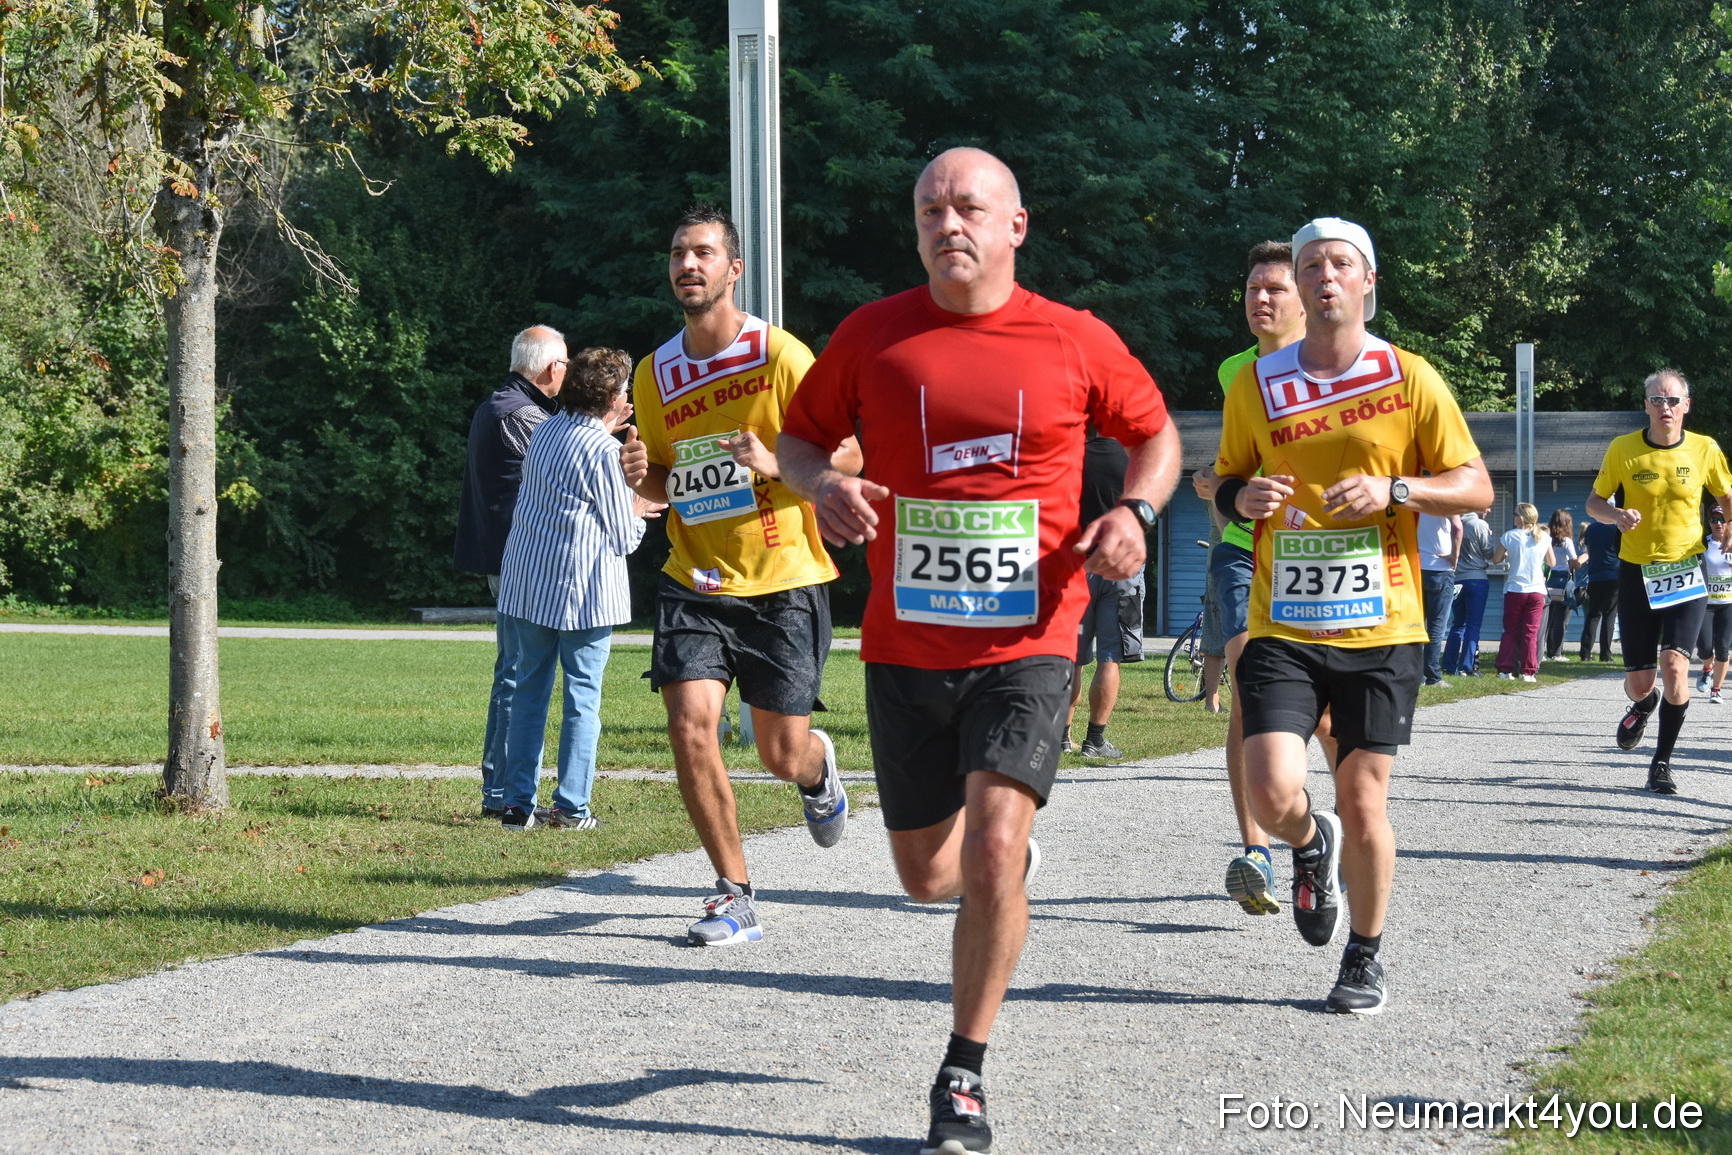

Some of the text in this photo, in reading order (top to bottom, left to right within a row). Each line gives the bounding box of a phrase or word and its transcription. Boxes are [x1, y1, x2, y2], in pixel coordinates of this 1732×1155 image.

[664, 375, 773, 430] MAX BÖGL
[1270, 393, 1411, 447] MAX BÖGL
[953, 445, 989, 461] DEHN
[672, 461, 739, 496] 2402
[1676, 466, 1690, 475] MTP
[686, 496, 731, 515] JOVAN
[907, 505, 1026, 534] BOCK
[1281, 532, 1371, 557] BOCK
[911, 544, 1020, 583] 2565
[1646, 557, 1695, 576] BOCK
[1285, 564, 1370, 595] 2373
[1652, 572, 1695, 594] 2737
[1708, 584, 1731, 592] 1042
[930, 594, 1000, 612] MARIO
[1282, 601, 1373, 618] CHRISTIAN
[1030, 739, 1047, 769] GORE
